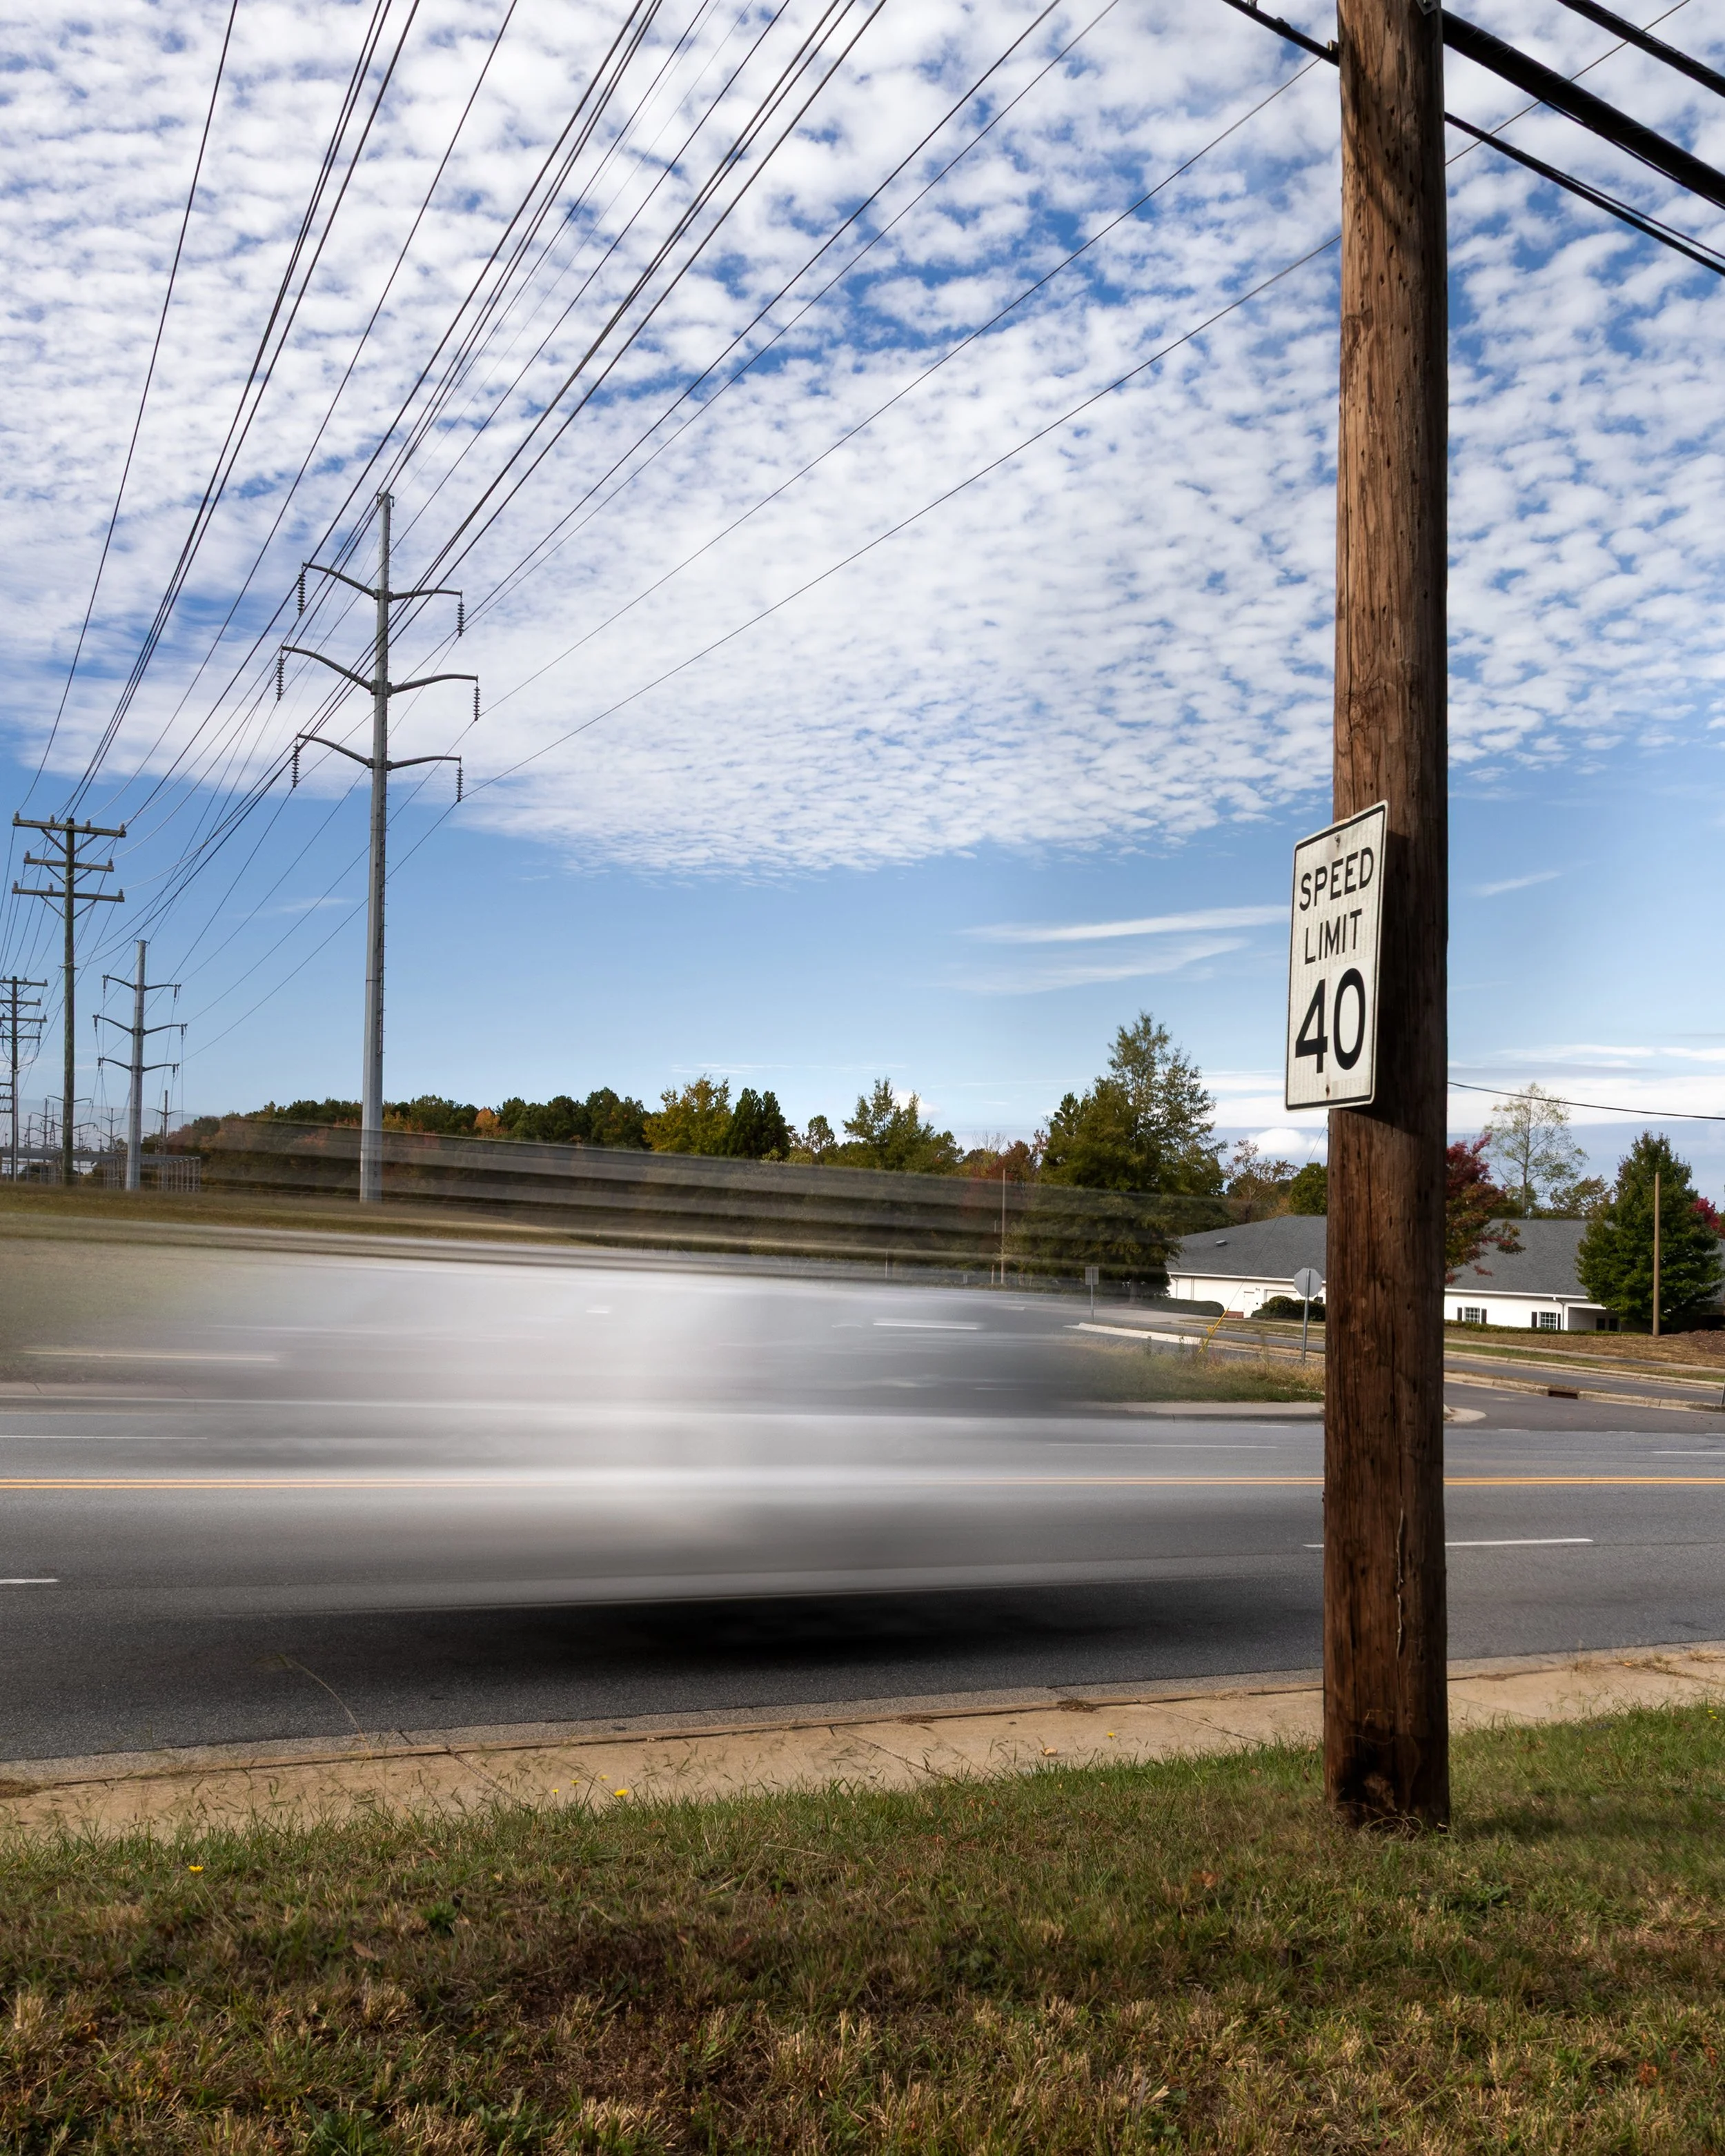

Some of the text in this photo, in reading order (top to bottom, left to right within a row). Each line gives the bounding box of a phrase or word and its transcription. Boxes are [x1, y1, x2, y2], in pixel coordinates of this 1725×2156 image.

[1299, 847, 1374, 911] SPEED
[1305, 909, 1363, 965] LIMIT
[1295, 967, 1366, 1074] 40
